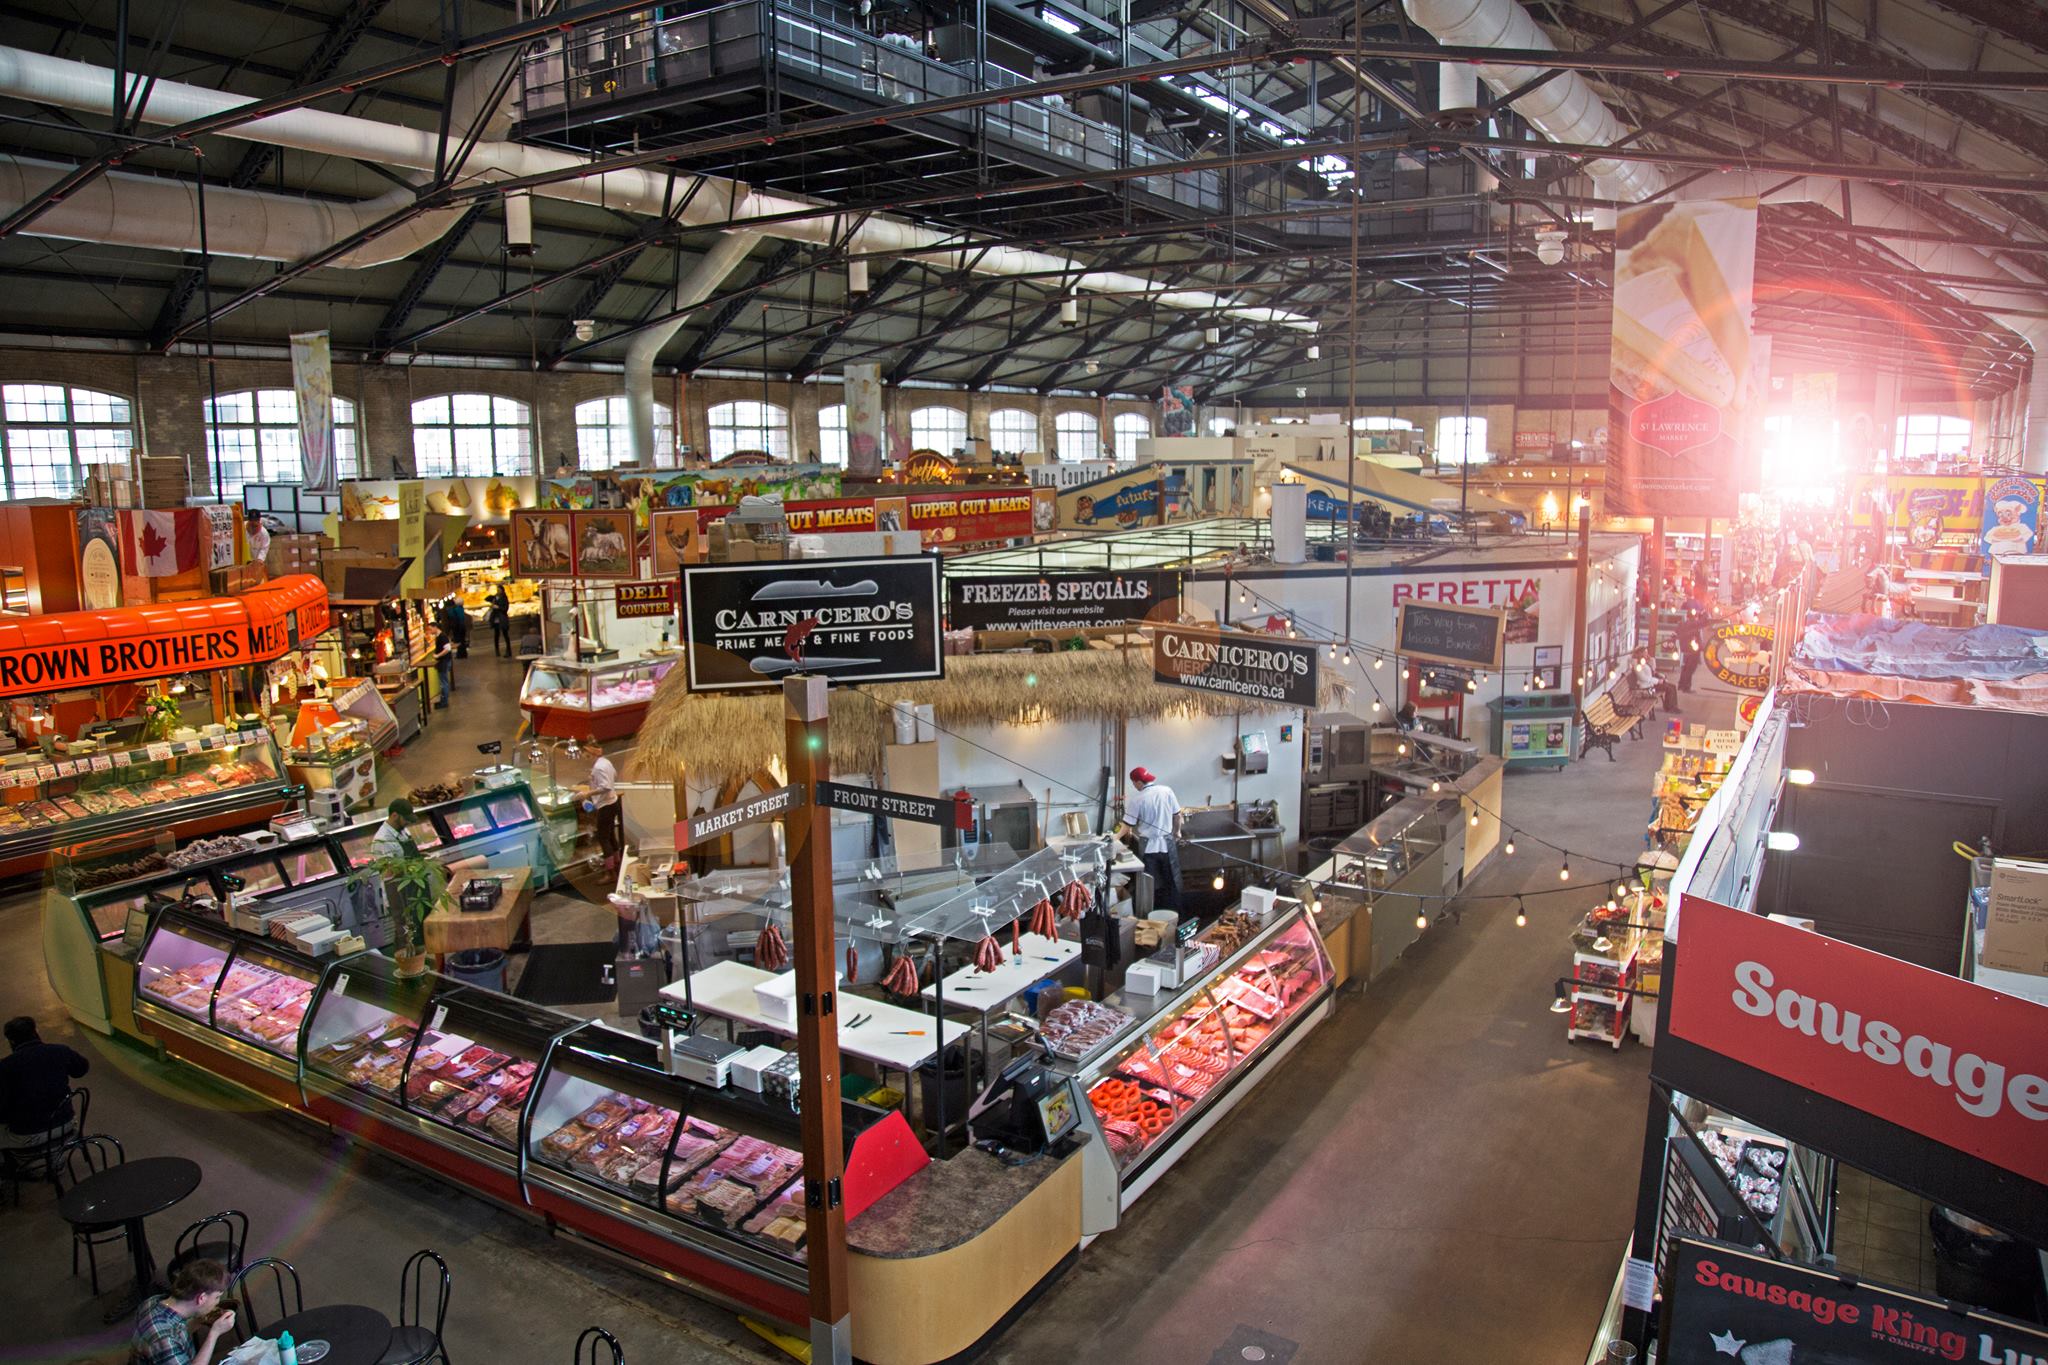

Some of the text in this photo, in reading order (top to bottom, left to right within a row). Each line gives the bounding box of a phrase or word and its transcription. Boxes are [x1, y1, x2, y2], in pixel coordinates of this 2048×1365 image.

[1652, 422, 1709, 432] LAWRENCE
[1031, 468, 1056, 487] Wine
[786, 506, 875, 529] UT MEATS
[911, 496, 1031, 519] UPPER CUT MEATS
[620, 585, 668, 600] DELI
[962, 580, 1149, 603] FREEZER SPECIALS
[1393, 578, 1541, 608] BERETTA
[620, 602, 671, 615] COUNTER
[715, 601, 914, 630] CARNICERO'S
[1008, 605, 1105, 616] Please visit our website
[716, 638, 756, 650] PRIME
[813, 635, 823, 646] &
[830, 632, 860, 644] FINE
[869, 629, 914, 642] FOODS
[1717, 623, 1775, 641] CAROUSE
[100, 629, 239, 675] BROTHERS
[249, 615, 287, 656] MEATS
[1162, 634, 1309, 676] CARNICERO'S
[1173, 657, 1295, 690] MERCADO LUNCH
[1718, 668, 1769, 688] BAKER
[1180, 673, 1285, 699] www.carnicero's.ca
[695, 792, 790, 838] MARKET STREET
[834, 789, 937, 818] FRONT STREET
[1732, 961, 2048, 1122] Sausage
[1695, 1260, 1860, 1325] Sausage
[1872, 1304, 1968, 1361] King
